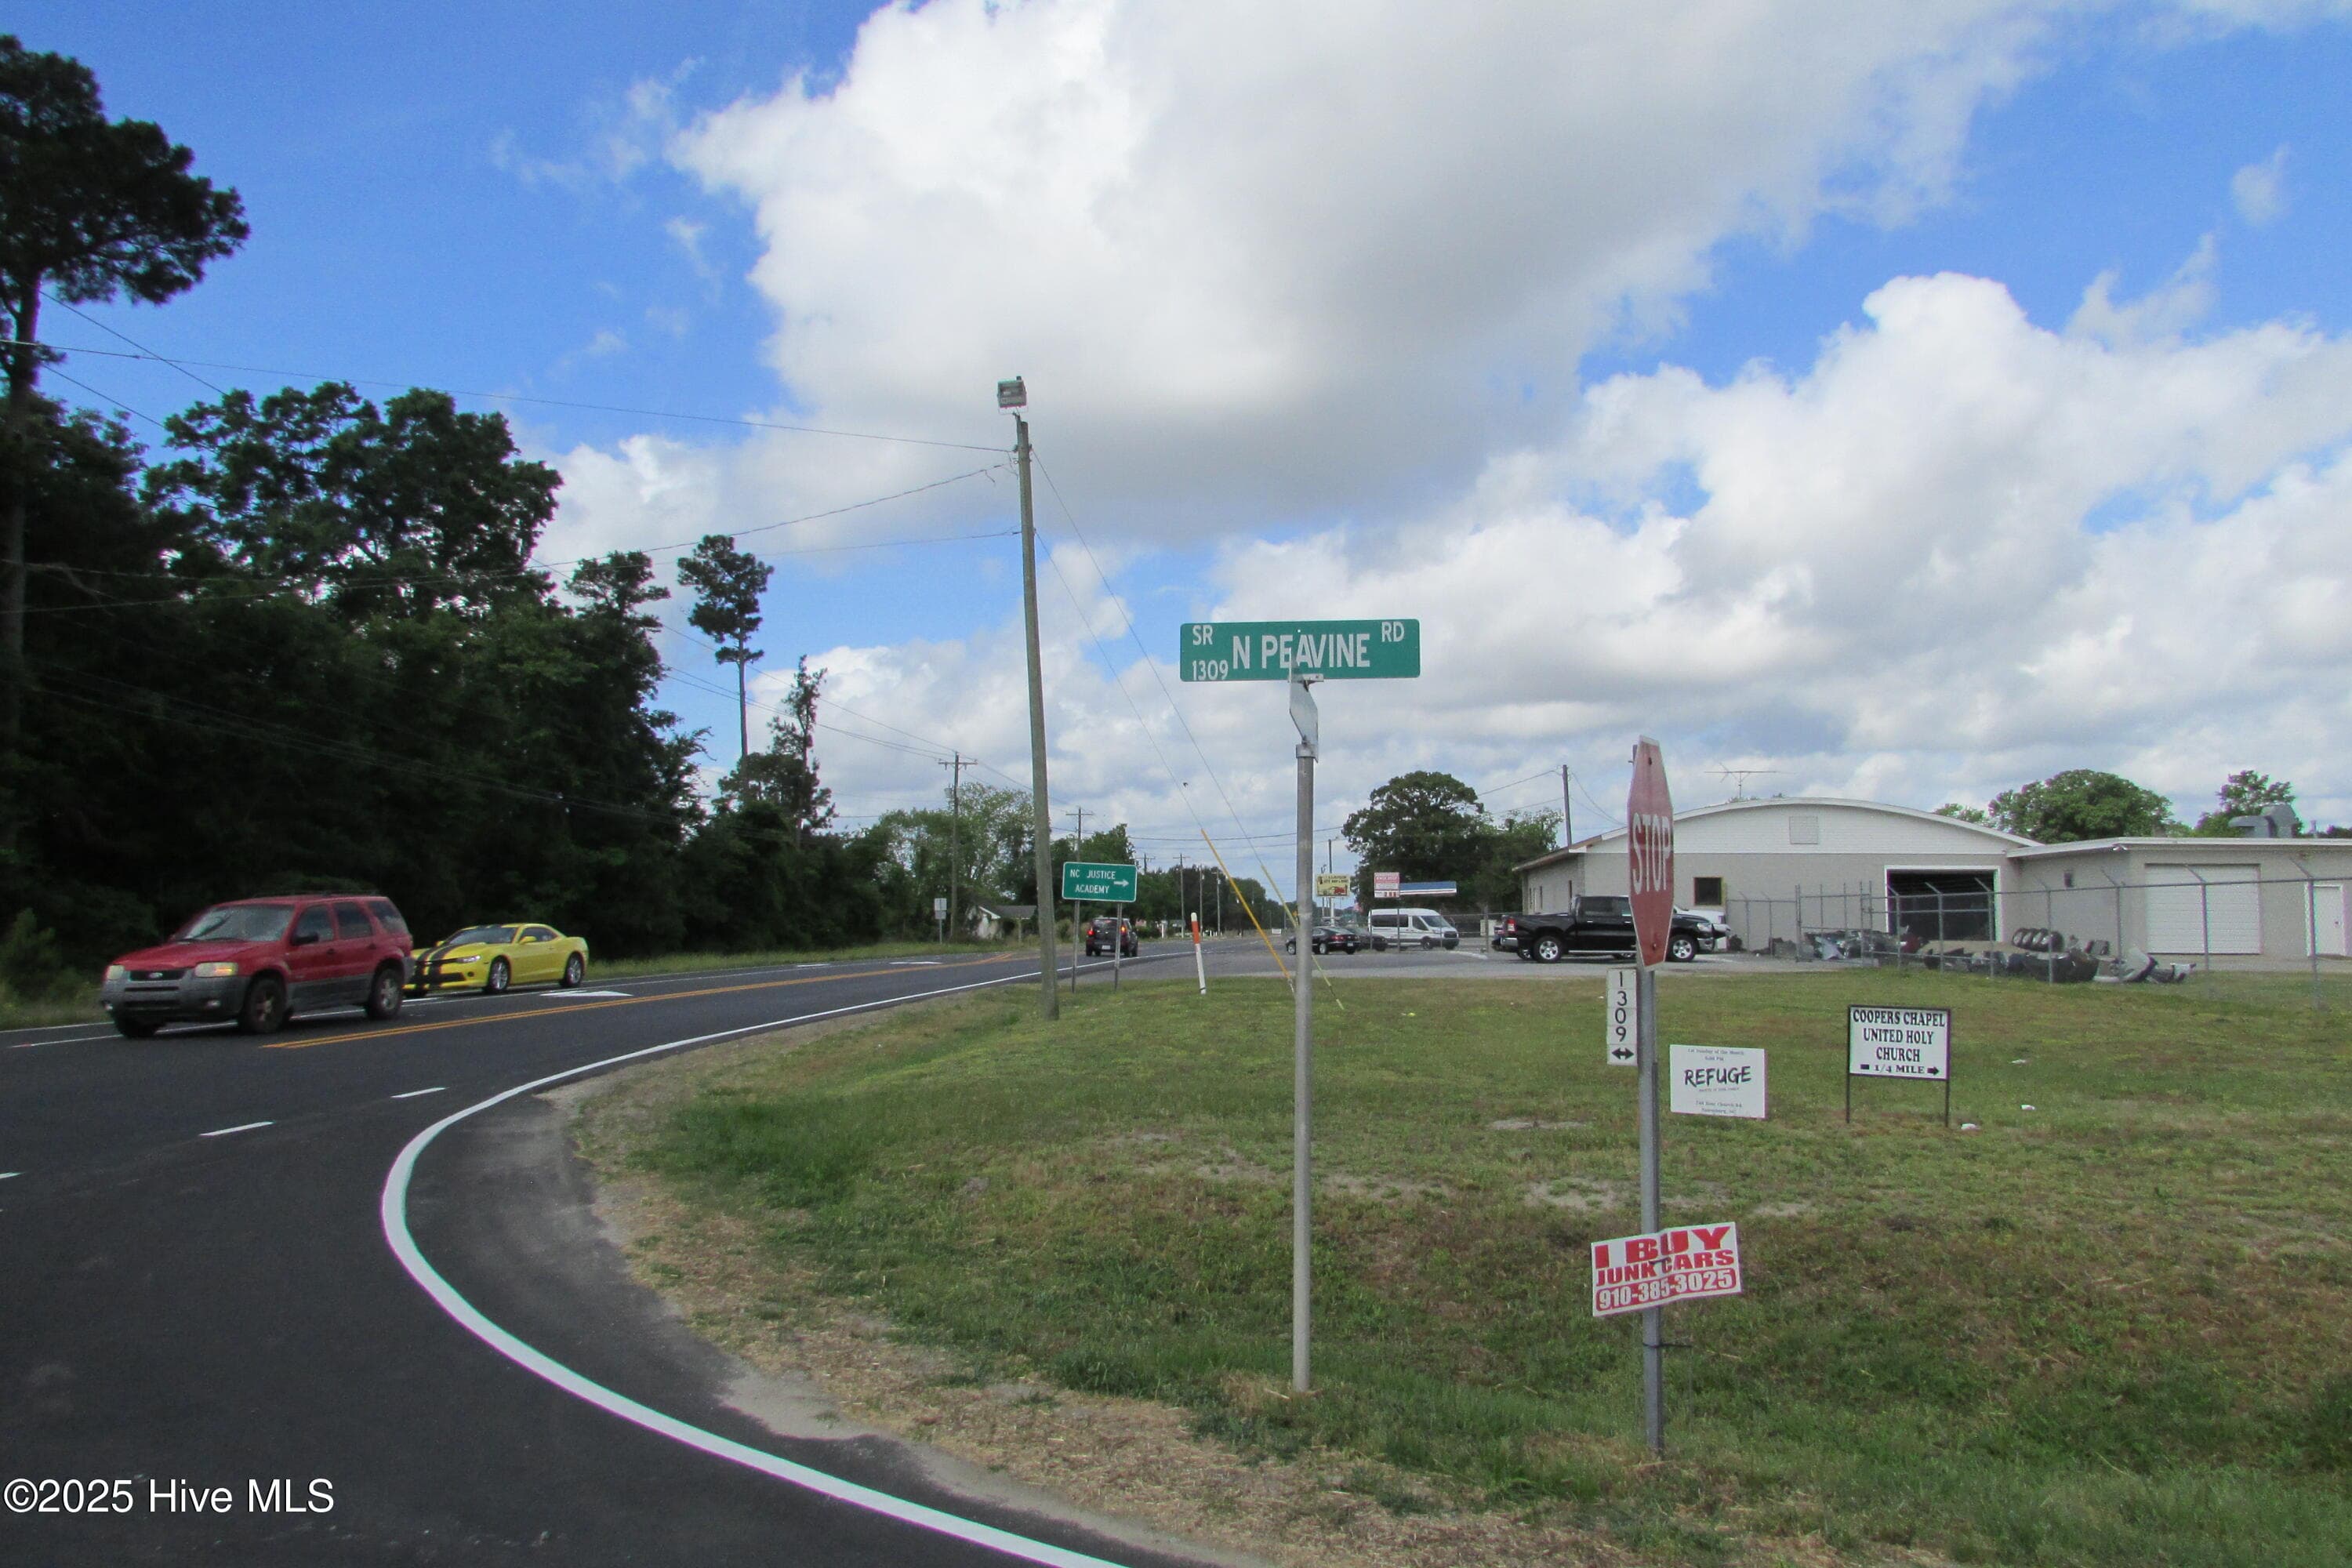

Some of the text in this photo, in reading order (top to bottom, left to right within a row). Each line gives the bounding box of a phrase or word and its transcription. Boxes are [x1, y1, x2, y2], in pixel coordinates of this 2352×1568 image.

[1192, 624, 1213, 646] SR
[1381, 621, 1405, 643] RD
[1232, 633, 1370, 670] N PEAVINE
[1192, 659, 1229, 681] 1309
[1632, 812, 1671, 895] STOP
[1069, 869, 1116, 880] NC JUSTICE
[1075, 884, 1110, 894] ACADEMY
[1853, 1009, 1945, 1027] COOPERS CHAPEL
[1863, 1028, 1934, 1044] UNITED HOLY
[1876, 1047, 1920, 1062] CHURCH
[1684, 1065, 1752, 1088] REFUGE
[1875, 1064, 1925, 1074] 1/4 MILE
[1595, 1226, 1731, 1269] I BUY
[1596, 1250, 1735, 1287] JUNK CARS
[1599, 1269, 1733, 1310] 910-385-3025
